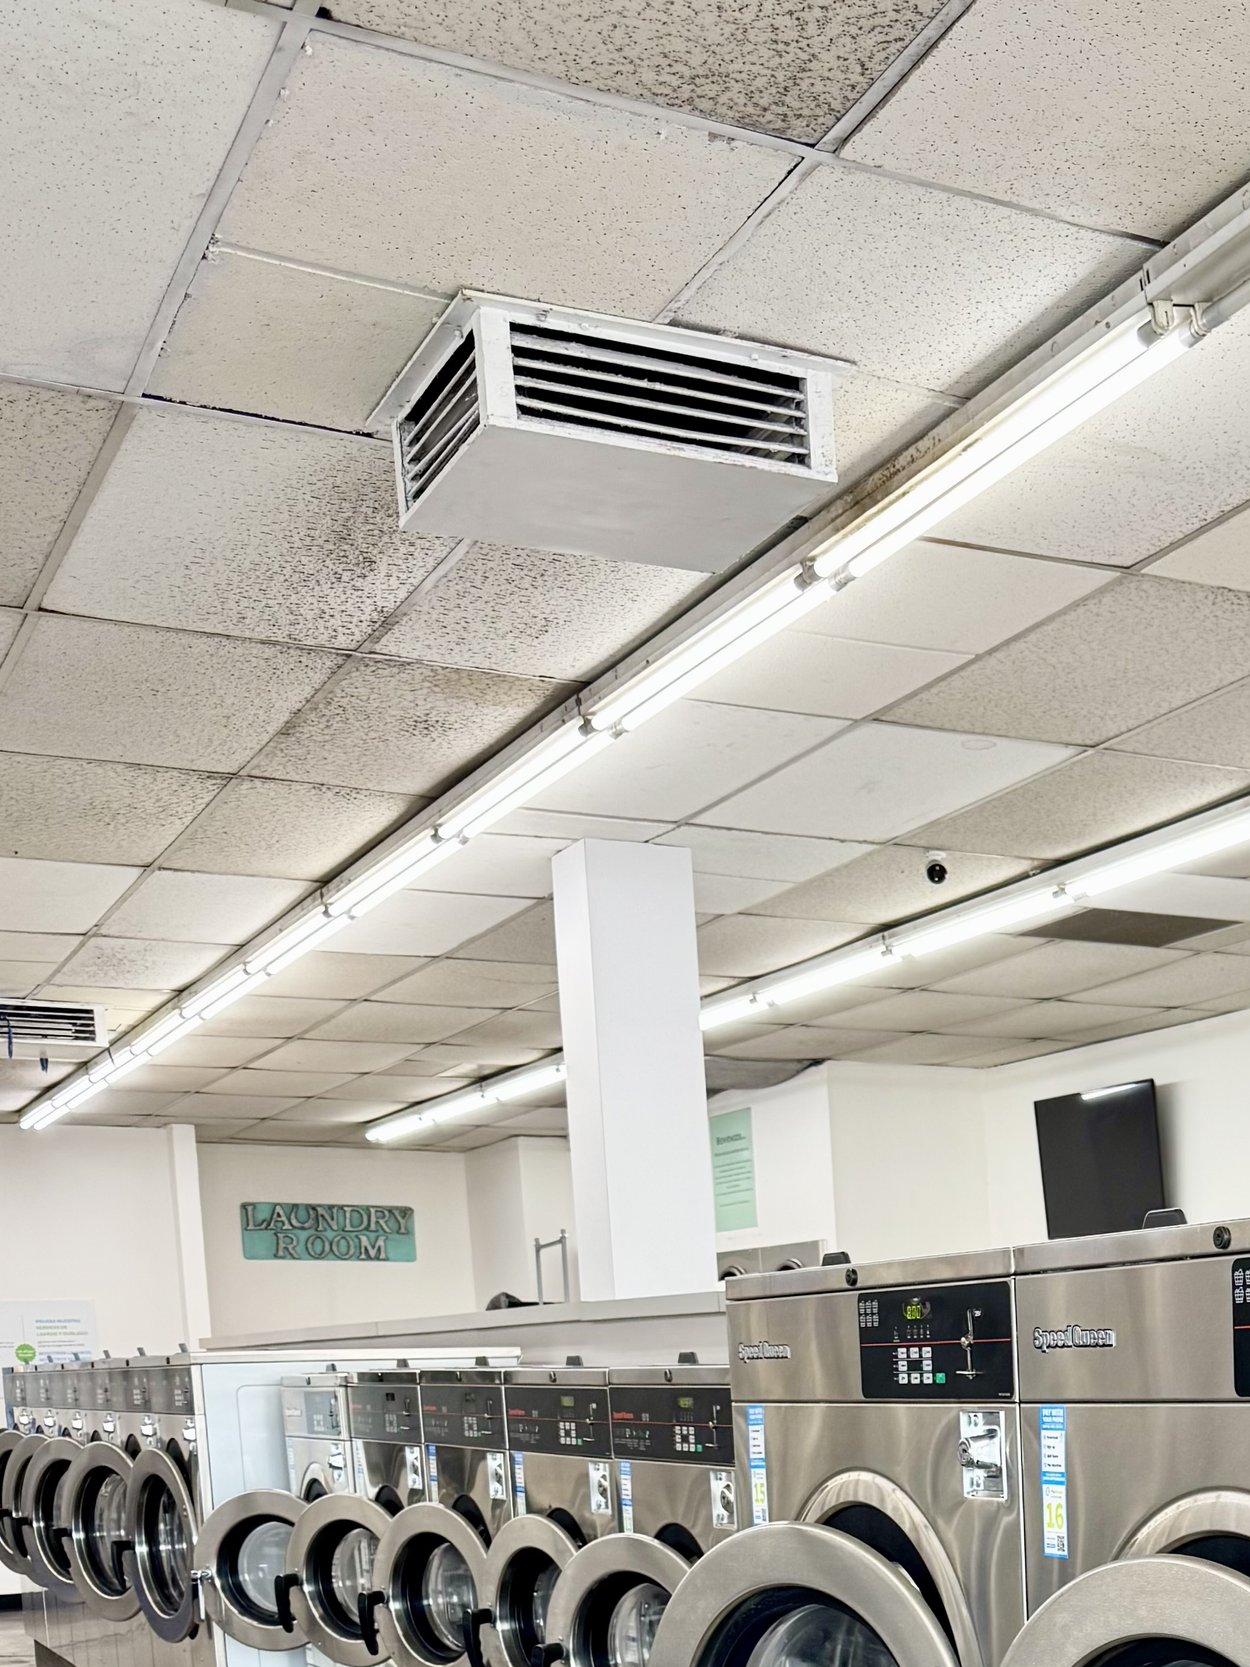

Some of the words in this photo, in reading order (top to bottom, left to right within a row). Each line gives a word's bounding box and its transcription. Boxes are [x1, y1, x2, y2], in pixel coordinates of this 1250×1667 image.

[243, 1204, 414, 1235] LAUNDRY
[273, 1231, 389, 1262] ROOM
[1033, 1325, 1072, 1353] Speed
[1072, 1324, 1116, 1348] Queen
[1046, 1502, 1064, 1530] 16
